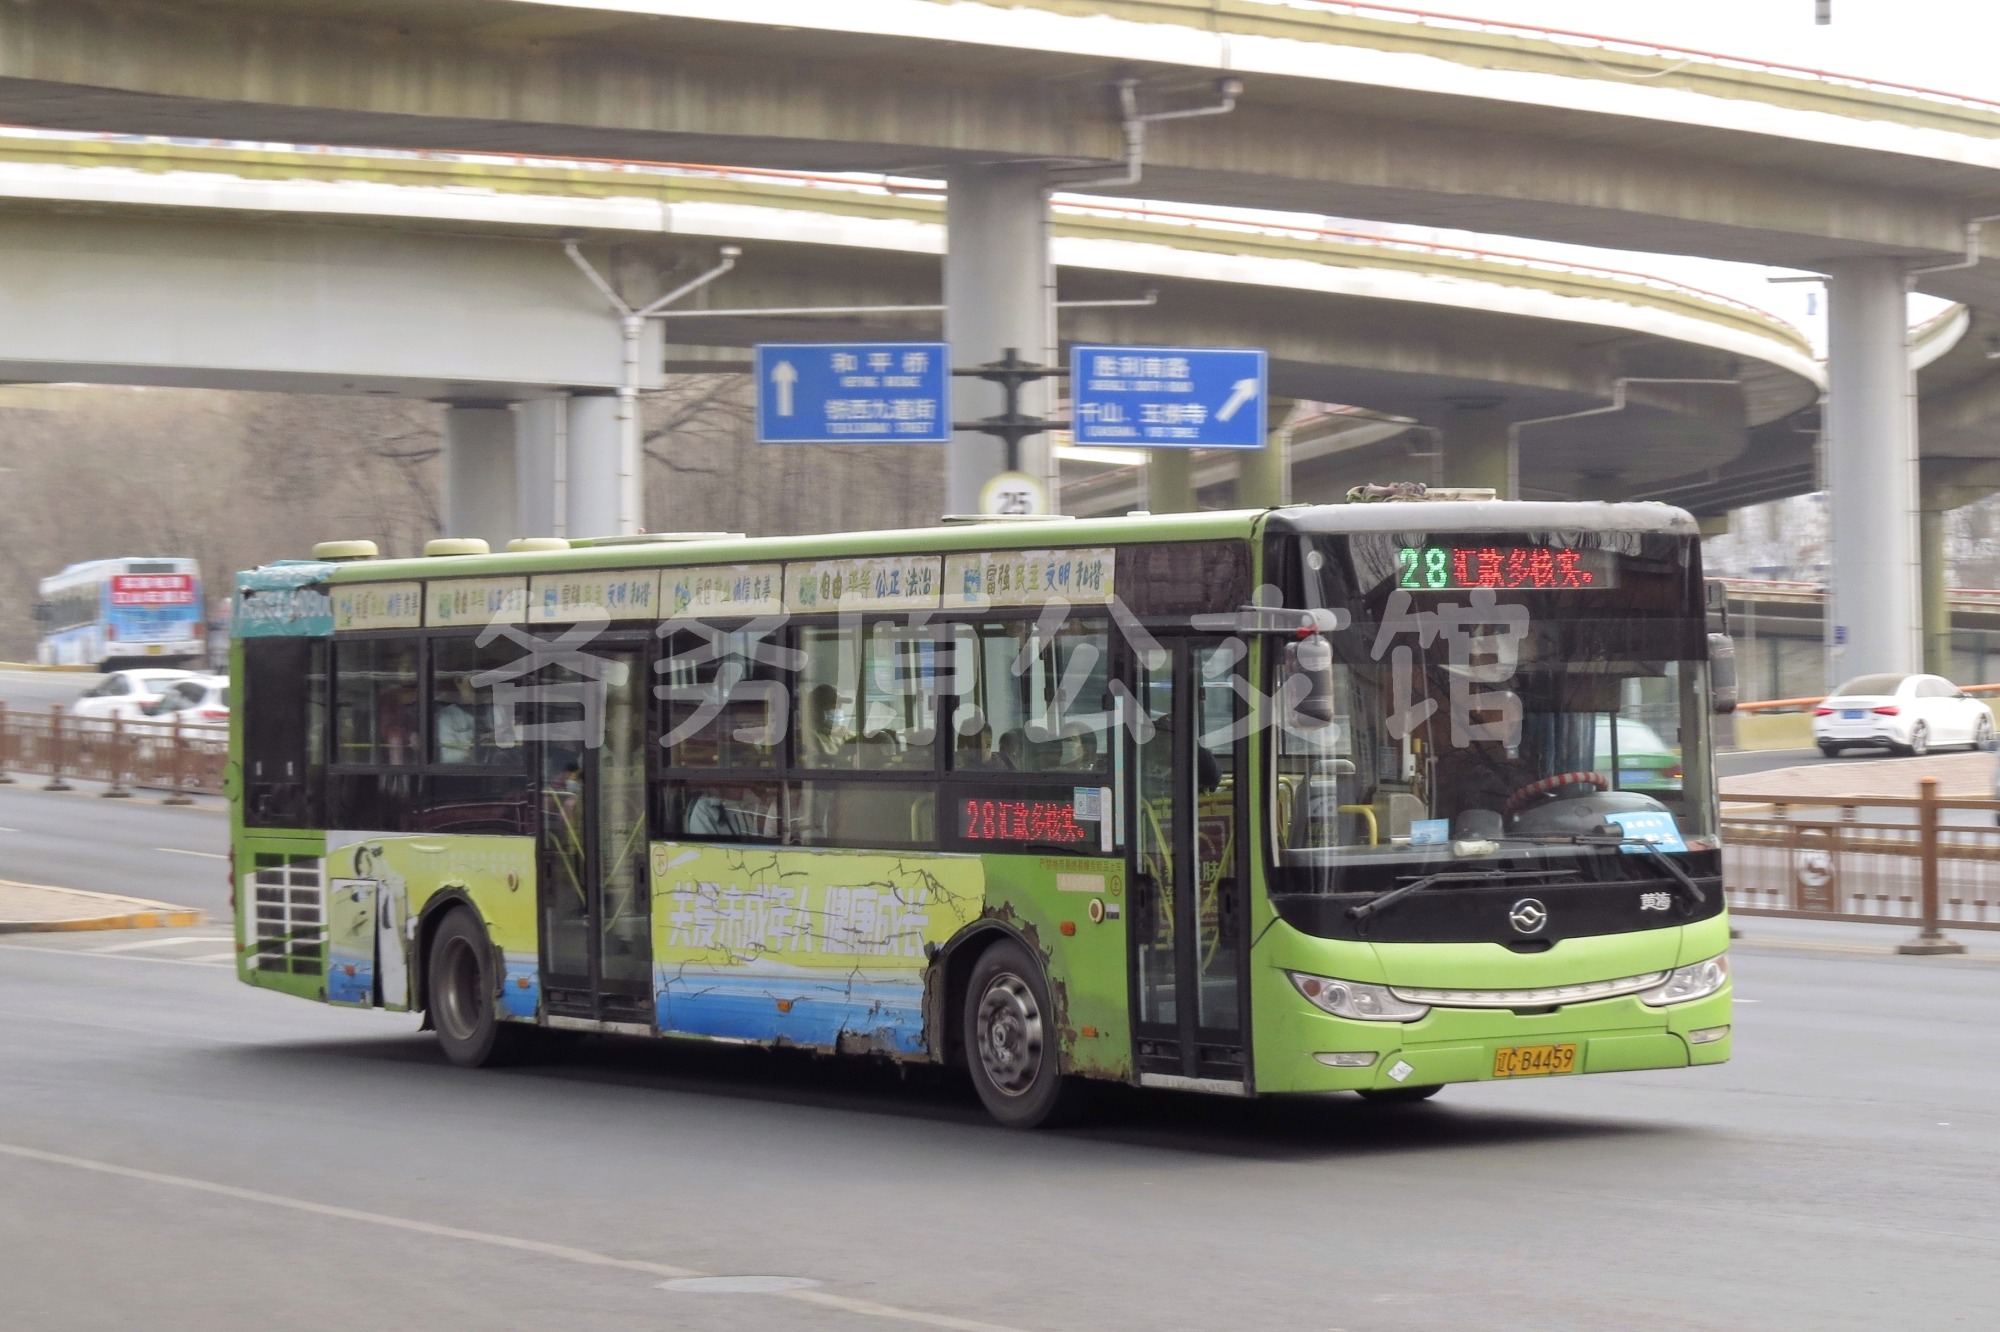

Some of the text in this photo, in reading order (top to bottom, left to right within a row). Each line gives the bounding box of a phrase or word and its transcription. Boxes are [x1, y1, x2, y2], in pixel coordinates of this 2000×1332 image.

[1092, 356, 1190, 378] 胜利南路
[998, 492, 1031, 515] 25
[820, 569, 843, 600] 自由
[876, 568, 901, 598] 公正
[905, 567, 932, 597] 法治
[986, 563, 1010, 595] 富强
[1014, 564, 1040, 592] 民主
[1044, 561, 1070, 592] 文明
[1400, 548, 1447, 588] 28
[669, 881, 929, 957] 关爱未成年人 健康成长
